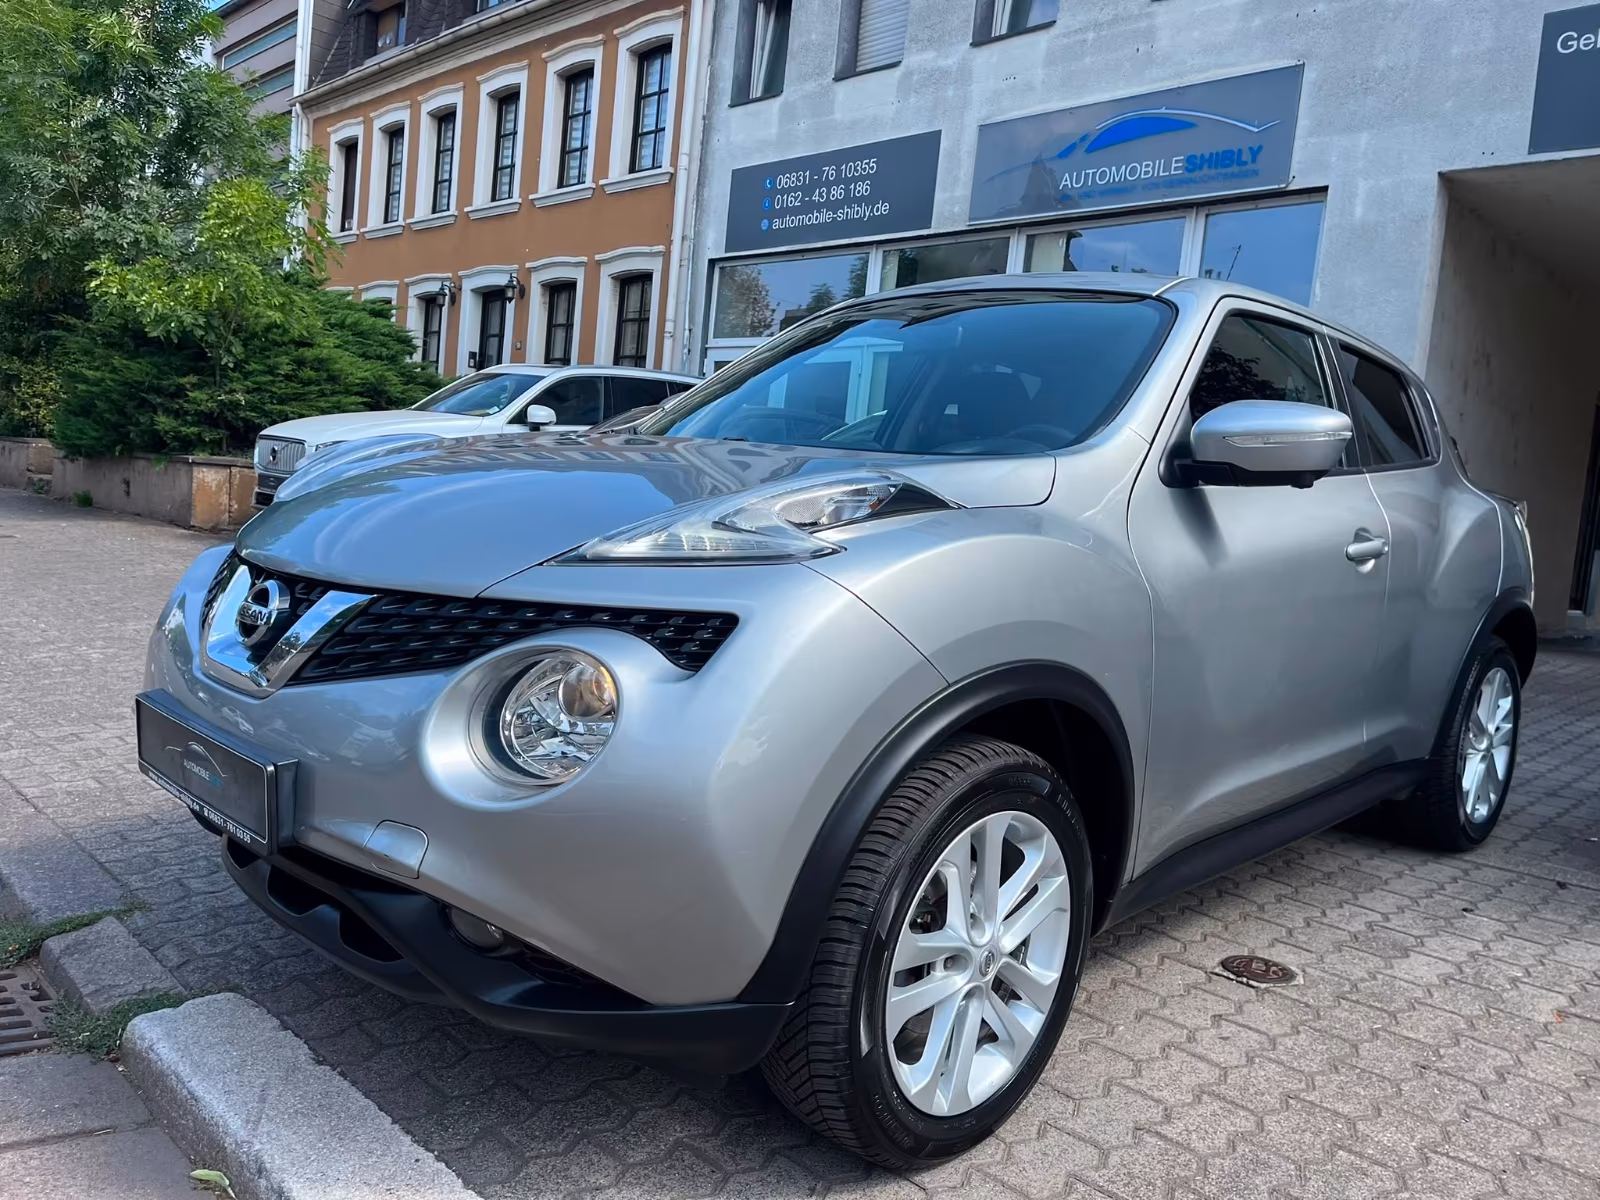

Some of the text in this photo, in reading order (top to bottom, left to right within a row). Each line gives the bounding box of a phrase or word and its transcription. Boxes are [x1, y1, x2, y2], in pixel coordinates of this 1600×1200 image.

[776, 170, 810, 189] 06831
[822, 166, 836, 181] 76
[840, 158, 877, 178] 10355
[774, 191, 802, 209] 0162
[812, 188, 827, 203] 43
[830, 185, 844, 200] 86
[849, 180, 870, 197] 186
[772, 200, 889, 229] automobile-shibly.de
